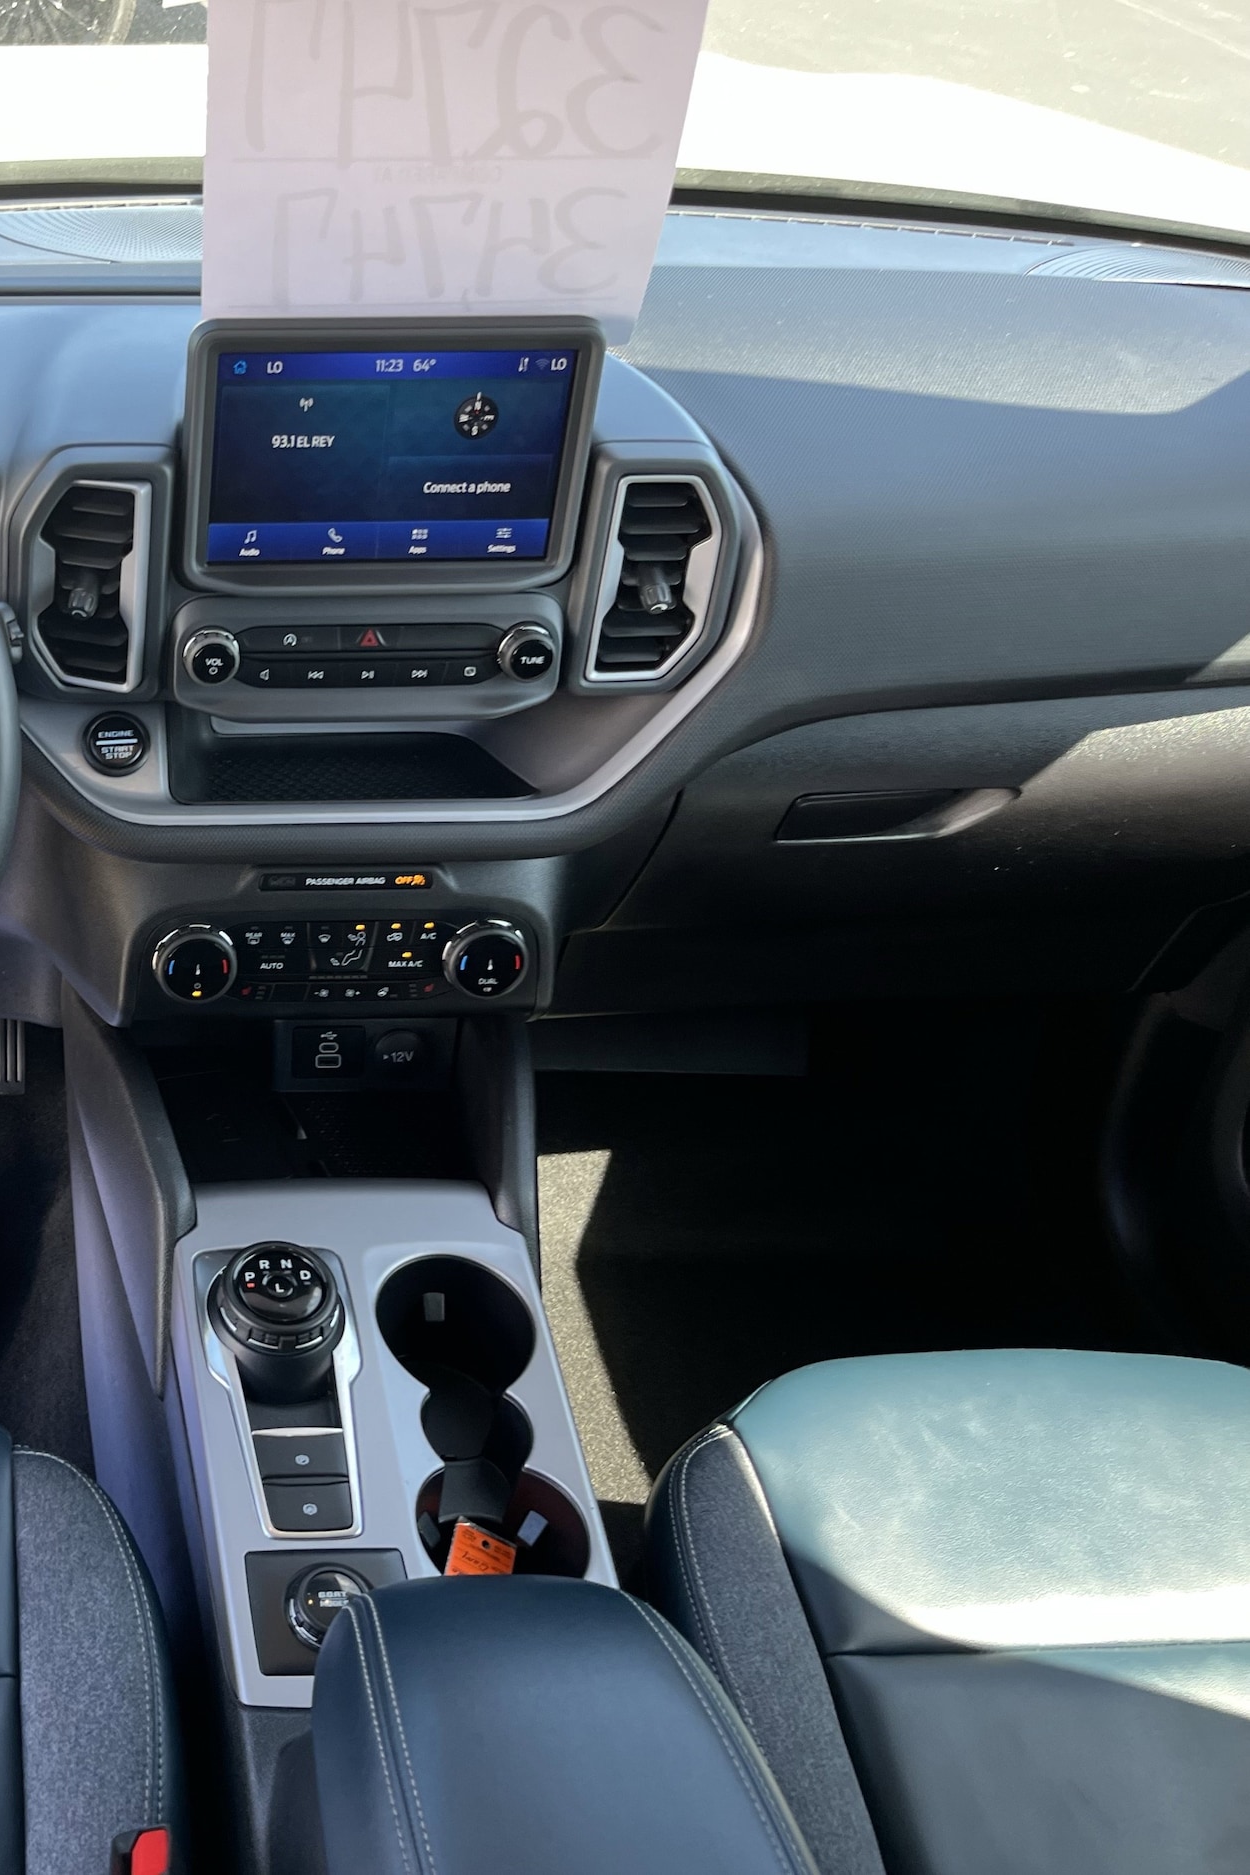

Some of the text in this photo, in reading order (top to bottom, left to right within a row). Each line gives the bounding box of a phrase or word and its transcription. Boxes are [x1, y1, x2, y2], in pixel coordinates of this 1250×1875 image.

[266, 360, 283, 374] LO
[375, 358, 404, 372] 11:23
[550, 358, 568, 371] LO
[271, 435, 335, 449] 93.1 EL REY
[422, 481, 512, 494] Connect a phone
[238, 547, 261, 557] Audio
[322, 546, 345, 556] Phone
[407, 545, 427, 555] Apps
[487, 544, 517, 554] Settings
[205, 658, 224, 666] VOL
[520, 655, 545, 665] TUNE
[98, 730, 135, 739] ENGINE
[101, 745, 135, 754] START
[105, 751, 133, 760] STOP
[305, 877, 354, 886] PASSENGER
[355, 876, 387, 886] AIRBAG
[394, 875, 414, 886] OFF
[420, 932, 437, 940] A/C
[260, 962, 284, 970] AUTO
[388, 960, 424, 968] MAX A/C
[390, 1051, 415, 1063] 12V
[259, 1260, 270, 1270] R
[280, 1259, 293, 1269] N
[244, 1271, 256, 1282] P
[299, 1270, 311, 1280] D
[274, 1283, 285, 1293] L
